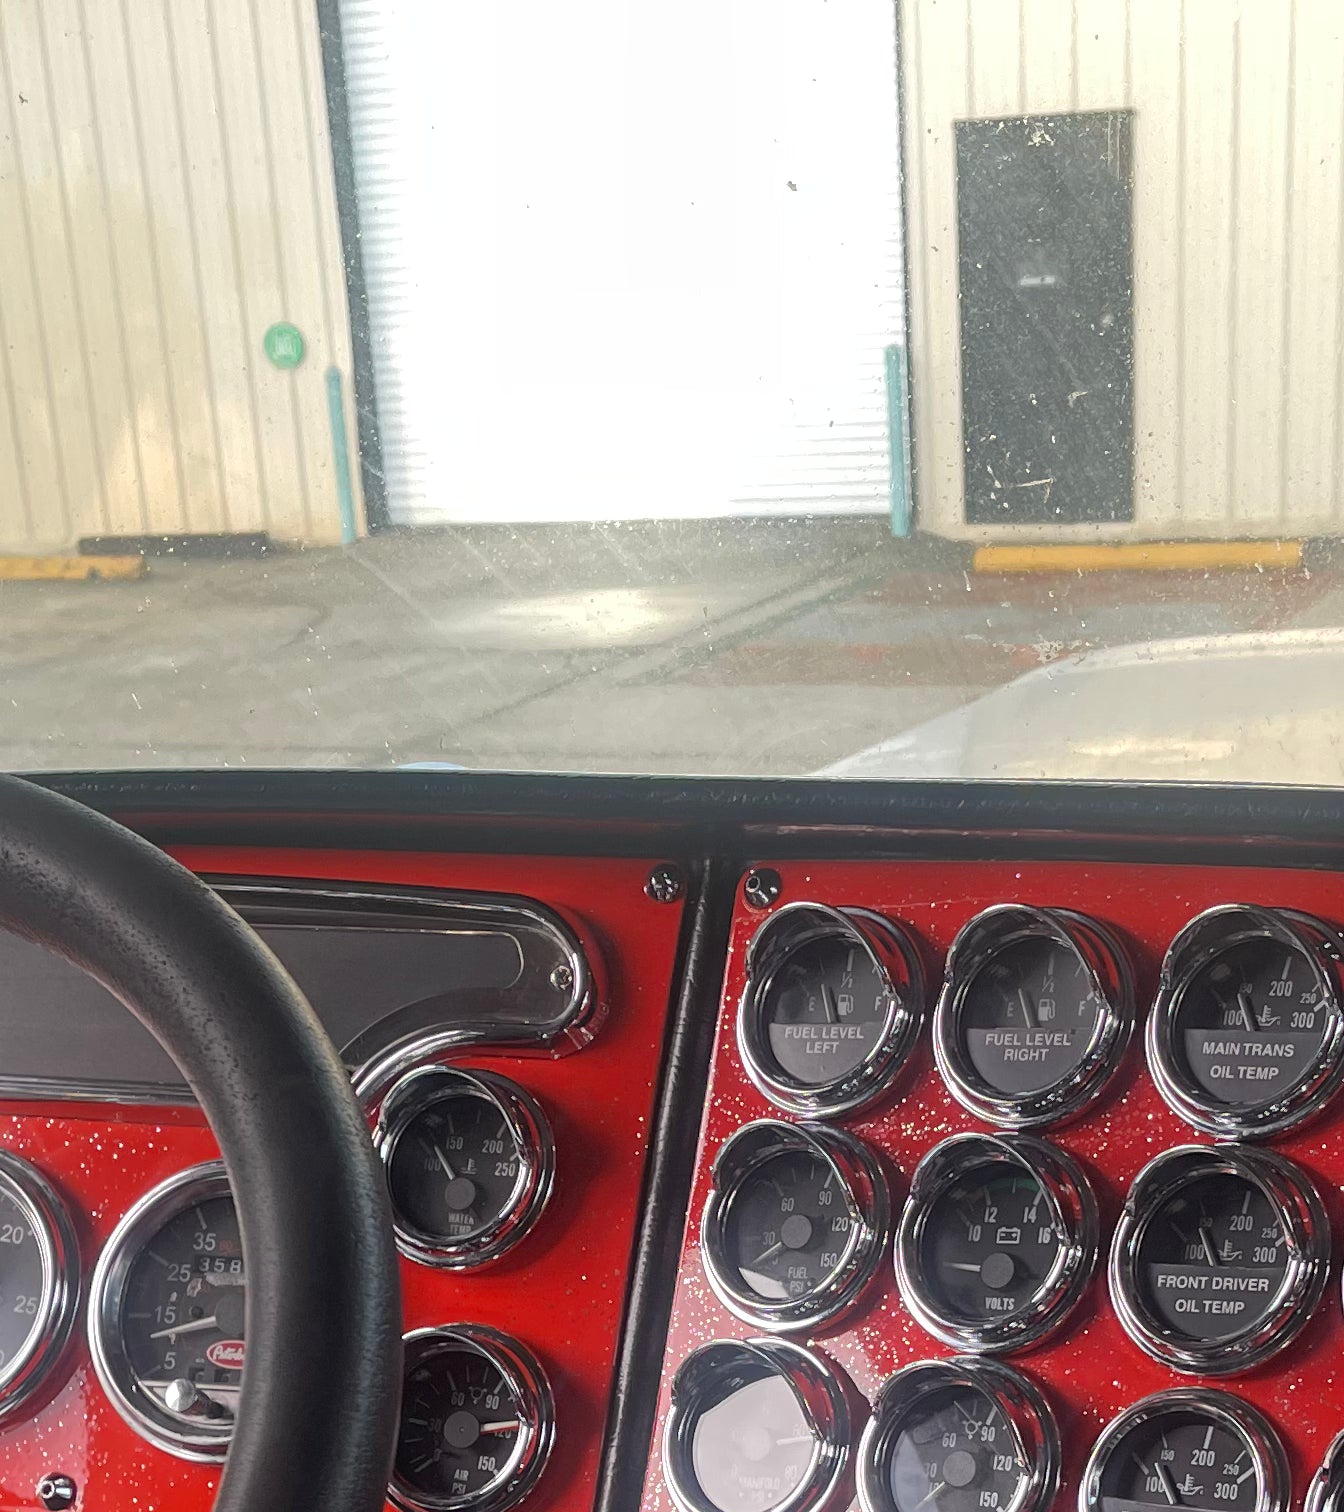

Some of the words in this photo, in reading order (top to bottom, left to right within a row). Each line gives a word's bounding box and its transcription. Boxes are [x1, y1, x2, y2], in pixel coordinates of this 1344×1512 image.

[1269, 981, 1293, 997] 200
[1291, 1012, 1314, 1028] 300
[785, 1027, 818, 1039] FUEL
[822, 1027, 864, 1039] LEVEL
[985, 1034, 1021, 1045] FUEL
[1026, 1034, 1071, 1046] LEVEL
[806, 1042, 839, 1053] LEFT
[1004, 1049, 1049, 1061] RIGHT
[1203, 1042, 1240, 1056] MAIN
[1243, 1043, 1294, 1057] TRANS
[1210, 1065, 1233, 1078] OIL
[1238, 1066, 1279, 1080] TEMP
[482, 1140, 503, 1153] 200
[494, 1163, 515, 1177] 250
[449, 1213, 474, 1224] WATER
[984, 1207, 998, 1223] 12
[1023, 1207, 1037, 1223] 14
[1230, 1216, 1254, 1231] 200
[0, 1226, 23, 1244] 20
[193, 1232, 216, 1250] 35
[1252, 1248, 1276, 1263] 300
[167, 1264, 191, 1282] 25
[788, 1267, 808, 1278] FUEL
[790, 1281, 803, 1292] PSI
[1157, 1275, 1208, 1289] FRONT
[1212, 1277, 1269, 1291] DRIVER
[13, 1295, 37, 1314] 25
[985, 1298, 1015, 1310] VOLTS
[1175, 1300, 1200, 1312] OIL
[1202, 1300, 1244, 1314] TEMP
[155, 1306, 176, 1324] 15
[164, 1352, 176, 1370] 5
[485, 1395, 499, 1410] 90
[981, 1427, 995, 1441] 90
[478, 1456, 495, 1471] 150
[993, 1455, 1012, 1470] 120
[1191, 1450, 1215, 1466] 200
[454, 1469, 469, 1481] AIR
[452, 1482, 466, 1494] PSI
[1214, 1484, 1238, 1500] 300
[980, 1491, 998, 1507] 150
